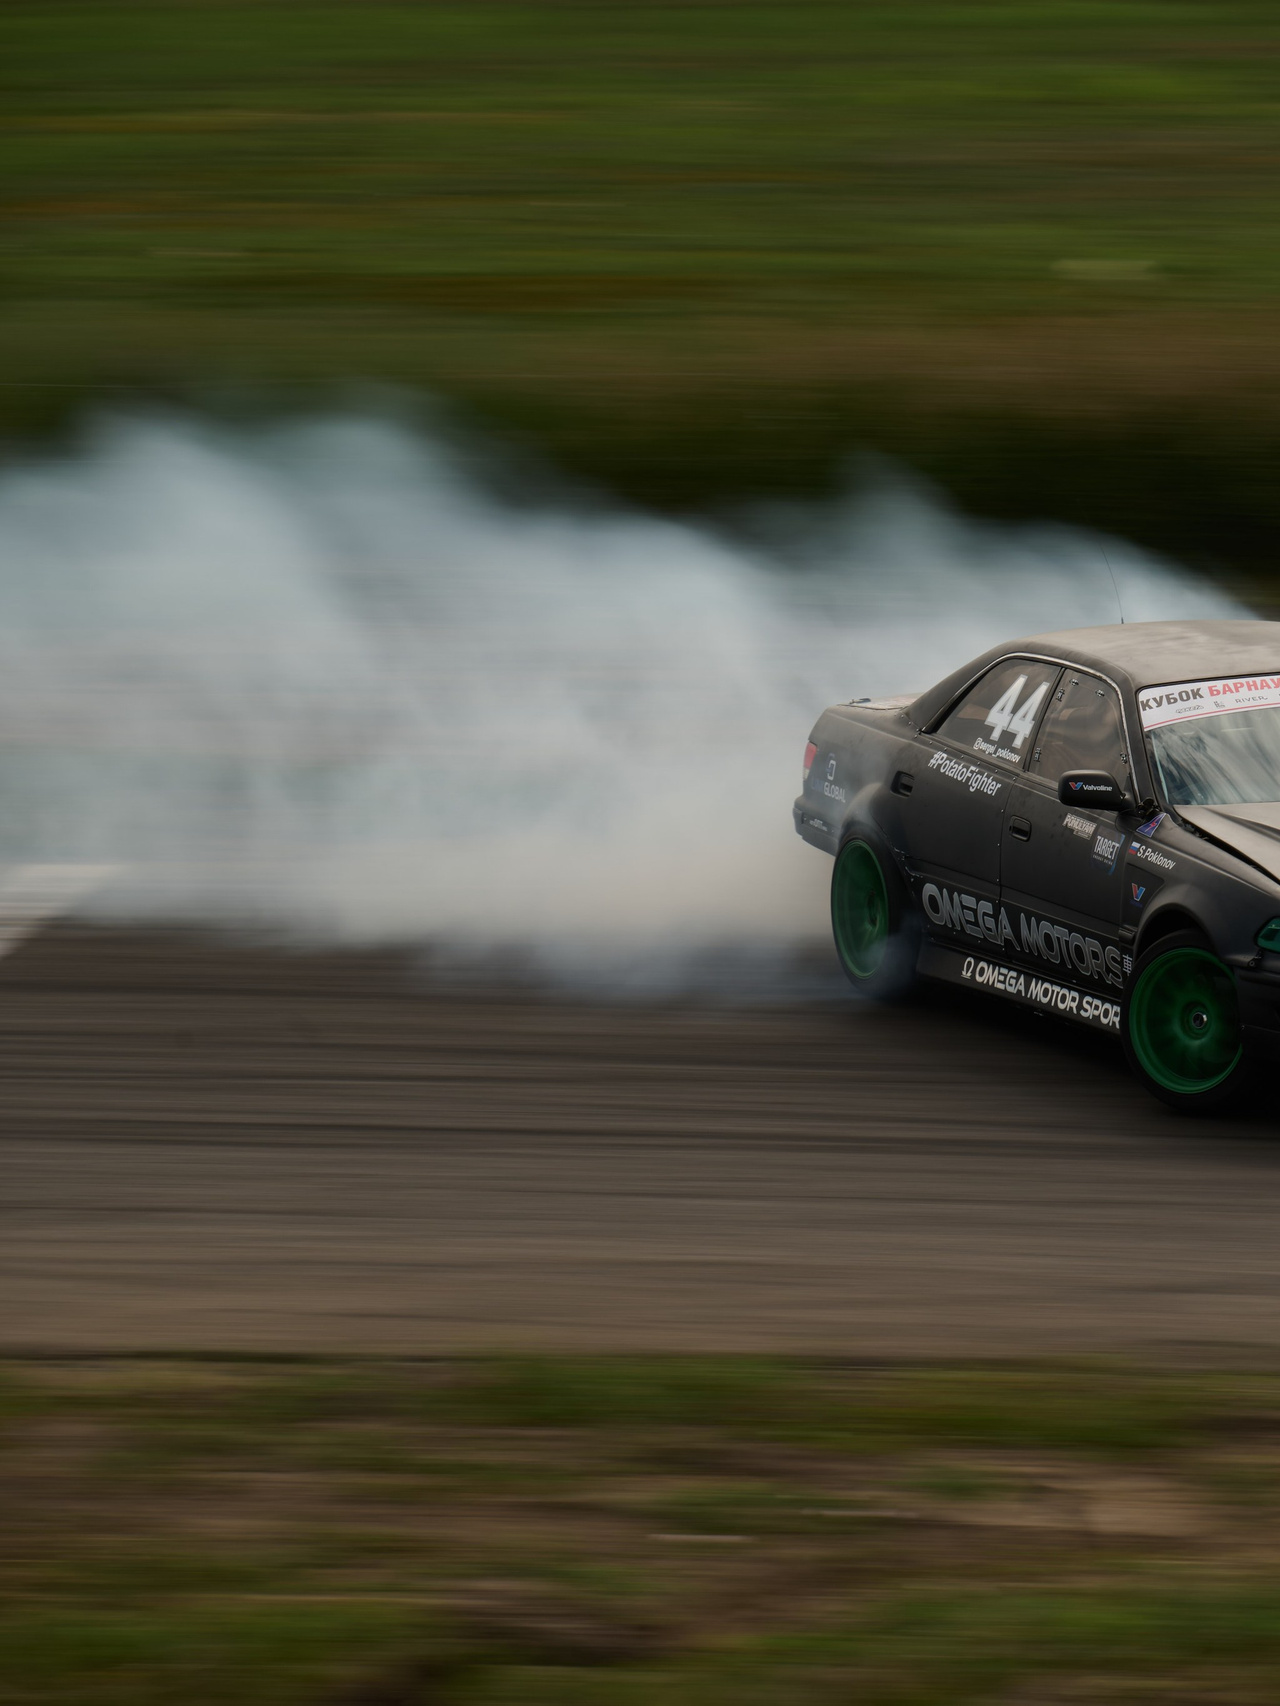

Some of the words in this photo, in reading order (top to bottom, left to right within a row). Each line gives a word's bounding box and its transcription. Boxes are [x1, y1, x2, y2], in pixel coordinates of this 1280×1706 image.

[984, 674, 1050, 749] 44
[1139, 687, 1204, 711] КУБОК
[928, 751, 1001, 796] #PotatoFighter
[1094, 835, 1120, 860] TARGET
[1137, 845, 1176, 870] S.Poklonov
[922, 883, 1020, 951] OMEGA
[1020, 913, 1123, 989] MOTORS
[975, 961, 1025, 997] OMEGA
[1027, 977, 1079, 1014] MOTOR
[1080, 995, 1120, 1029] SPOR
